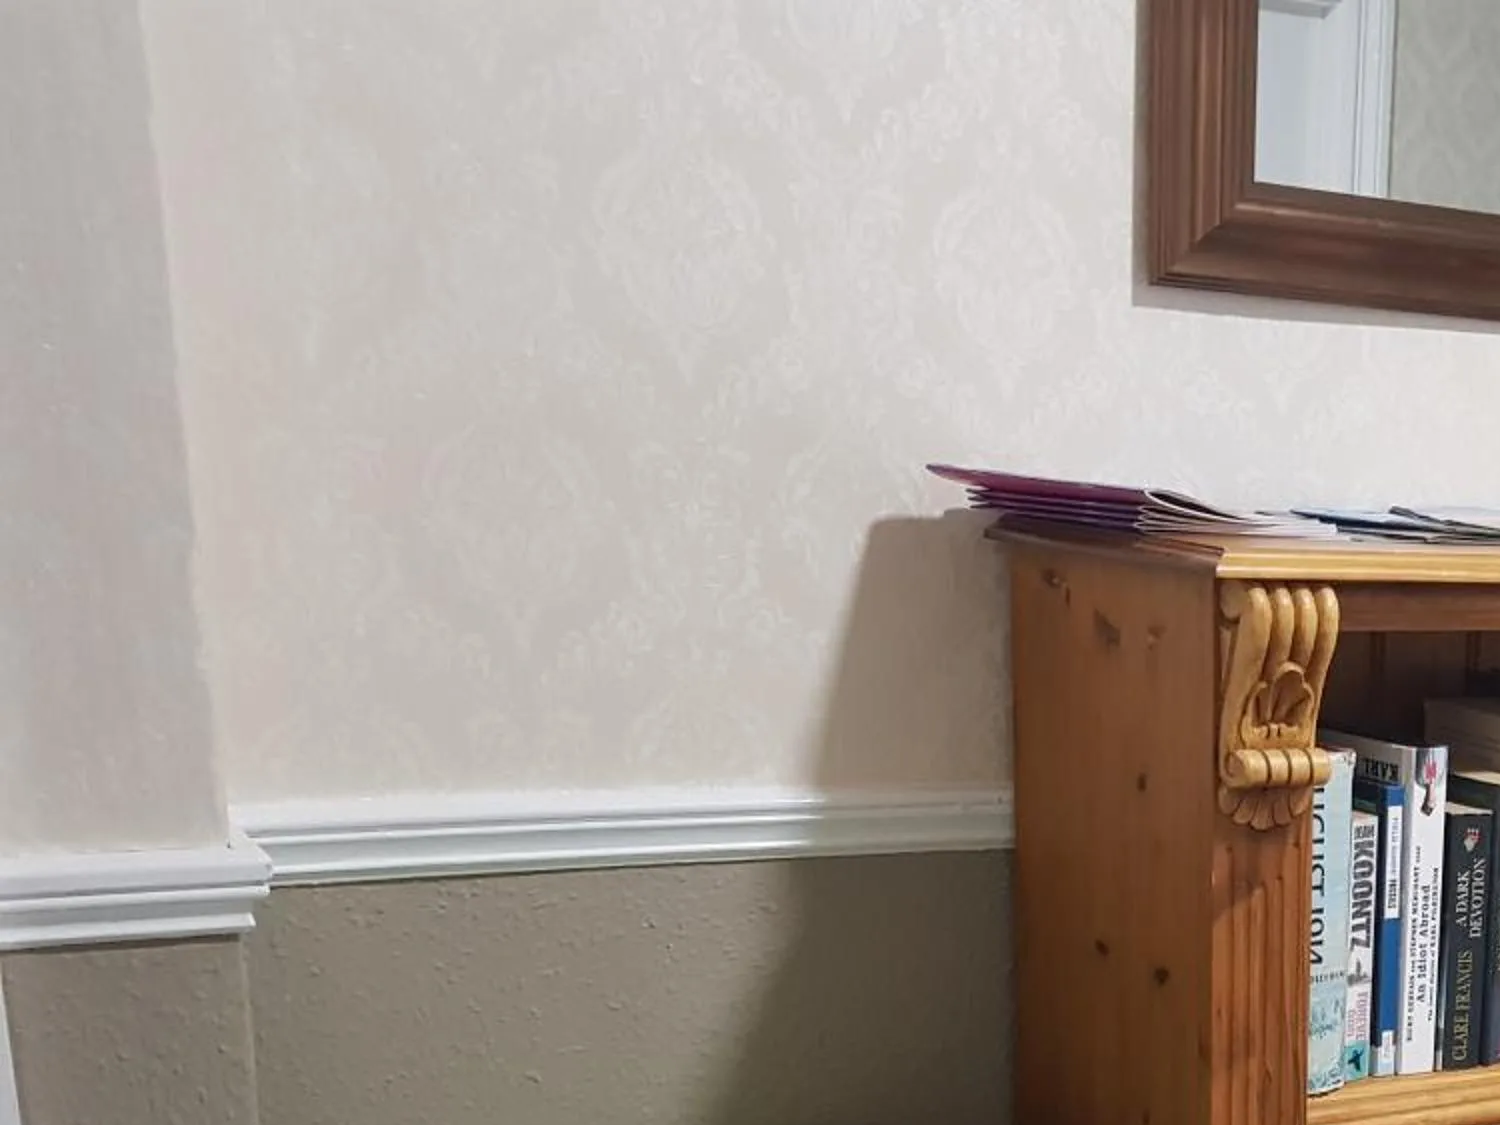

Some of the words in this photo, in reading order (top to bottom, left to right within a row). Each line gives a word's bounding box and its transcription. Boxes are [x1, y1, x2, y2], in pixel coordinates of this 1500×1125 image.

[1351, 841, 1375, 951] KOONTZ
[1418, 884, 1431, 939] Abroad
[1455, 869, 1471, 914] DARK
[1468, 857, 1487, 939] DEVOTION
[1456, 914, 1468, 928] A
[1416, 944, 1428, 979] Idiot
[1456, 950, 1474, 1011] FRANCIS
[1415, 984, 1426, 1004] An
[1452, 1014, 1470, 1062] CLARE
